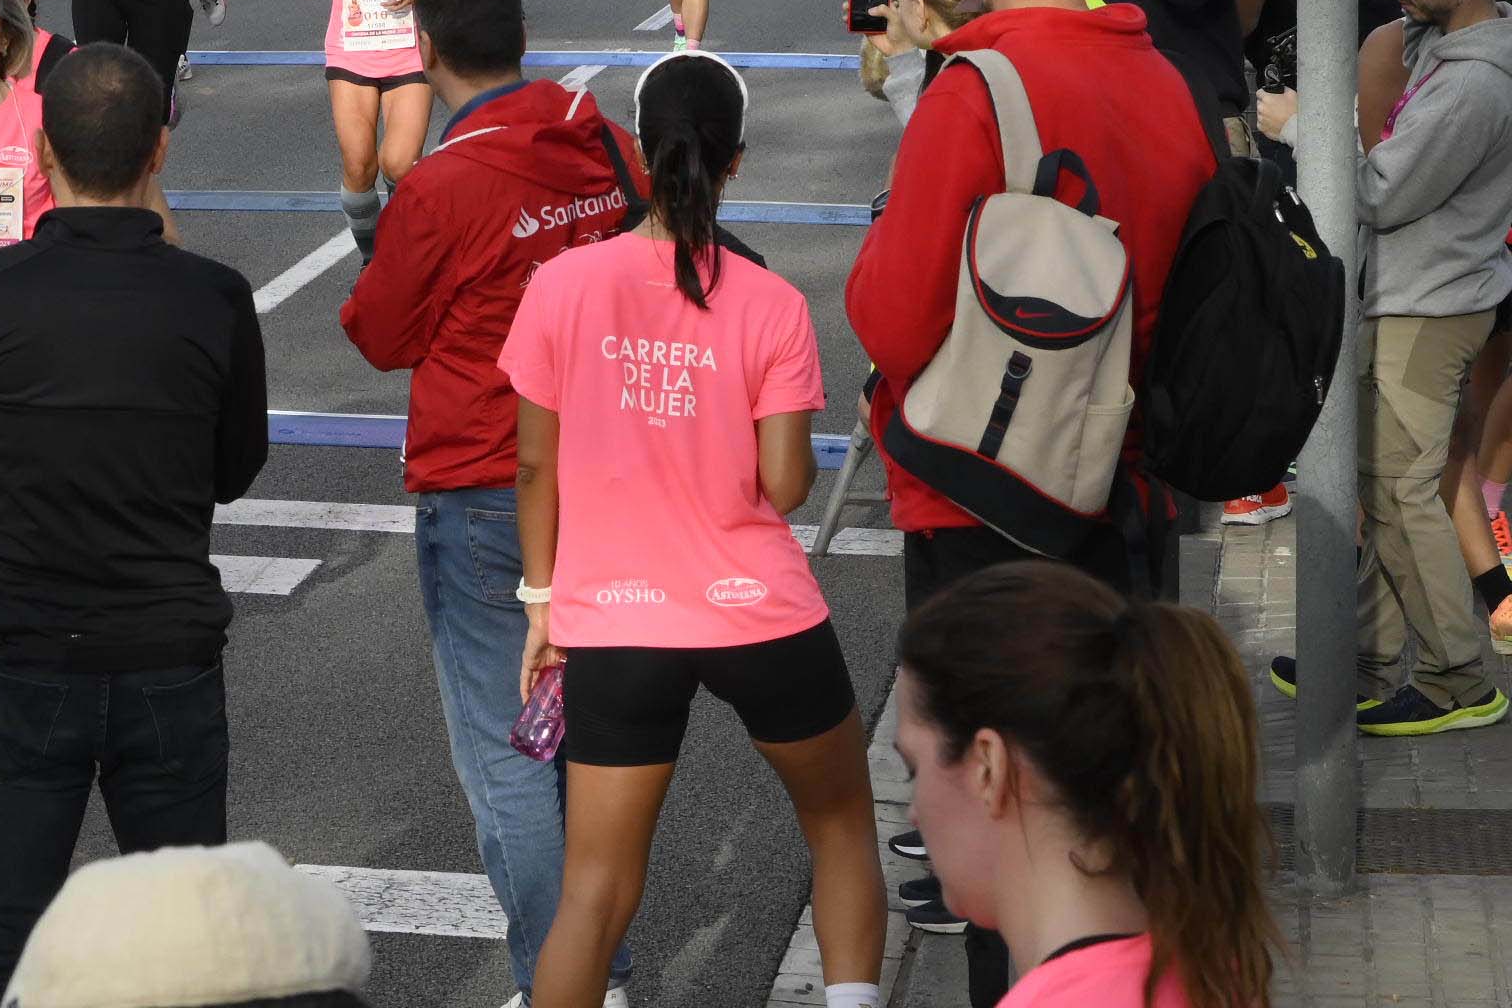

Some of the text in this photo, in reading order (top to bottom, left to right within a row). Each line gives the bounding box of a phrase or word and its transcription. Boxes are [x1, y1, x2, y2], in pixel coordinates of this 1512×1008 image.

[601, 335, 718, 371] CARRERA
[623, 362, 695, 392] DE LA
[620, 388, 697, 417] MUJER
[597, 588, 666, 605] OYSHO
